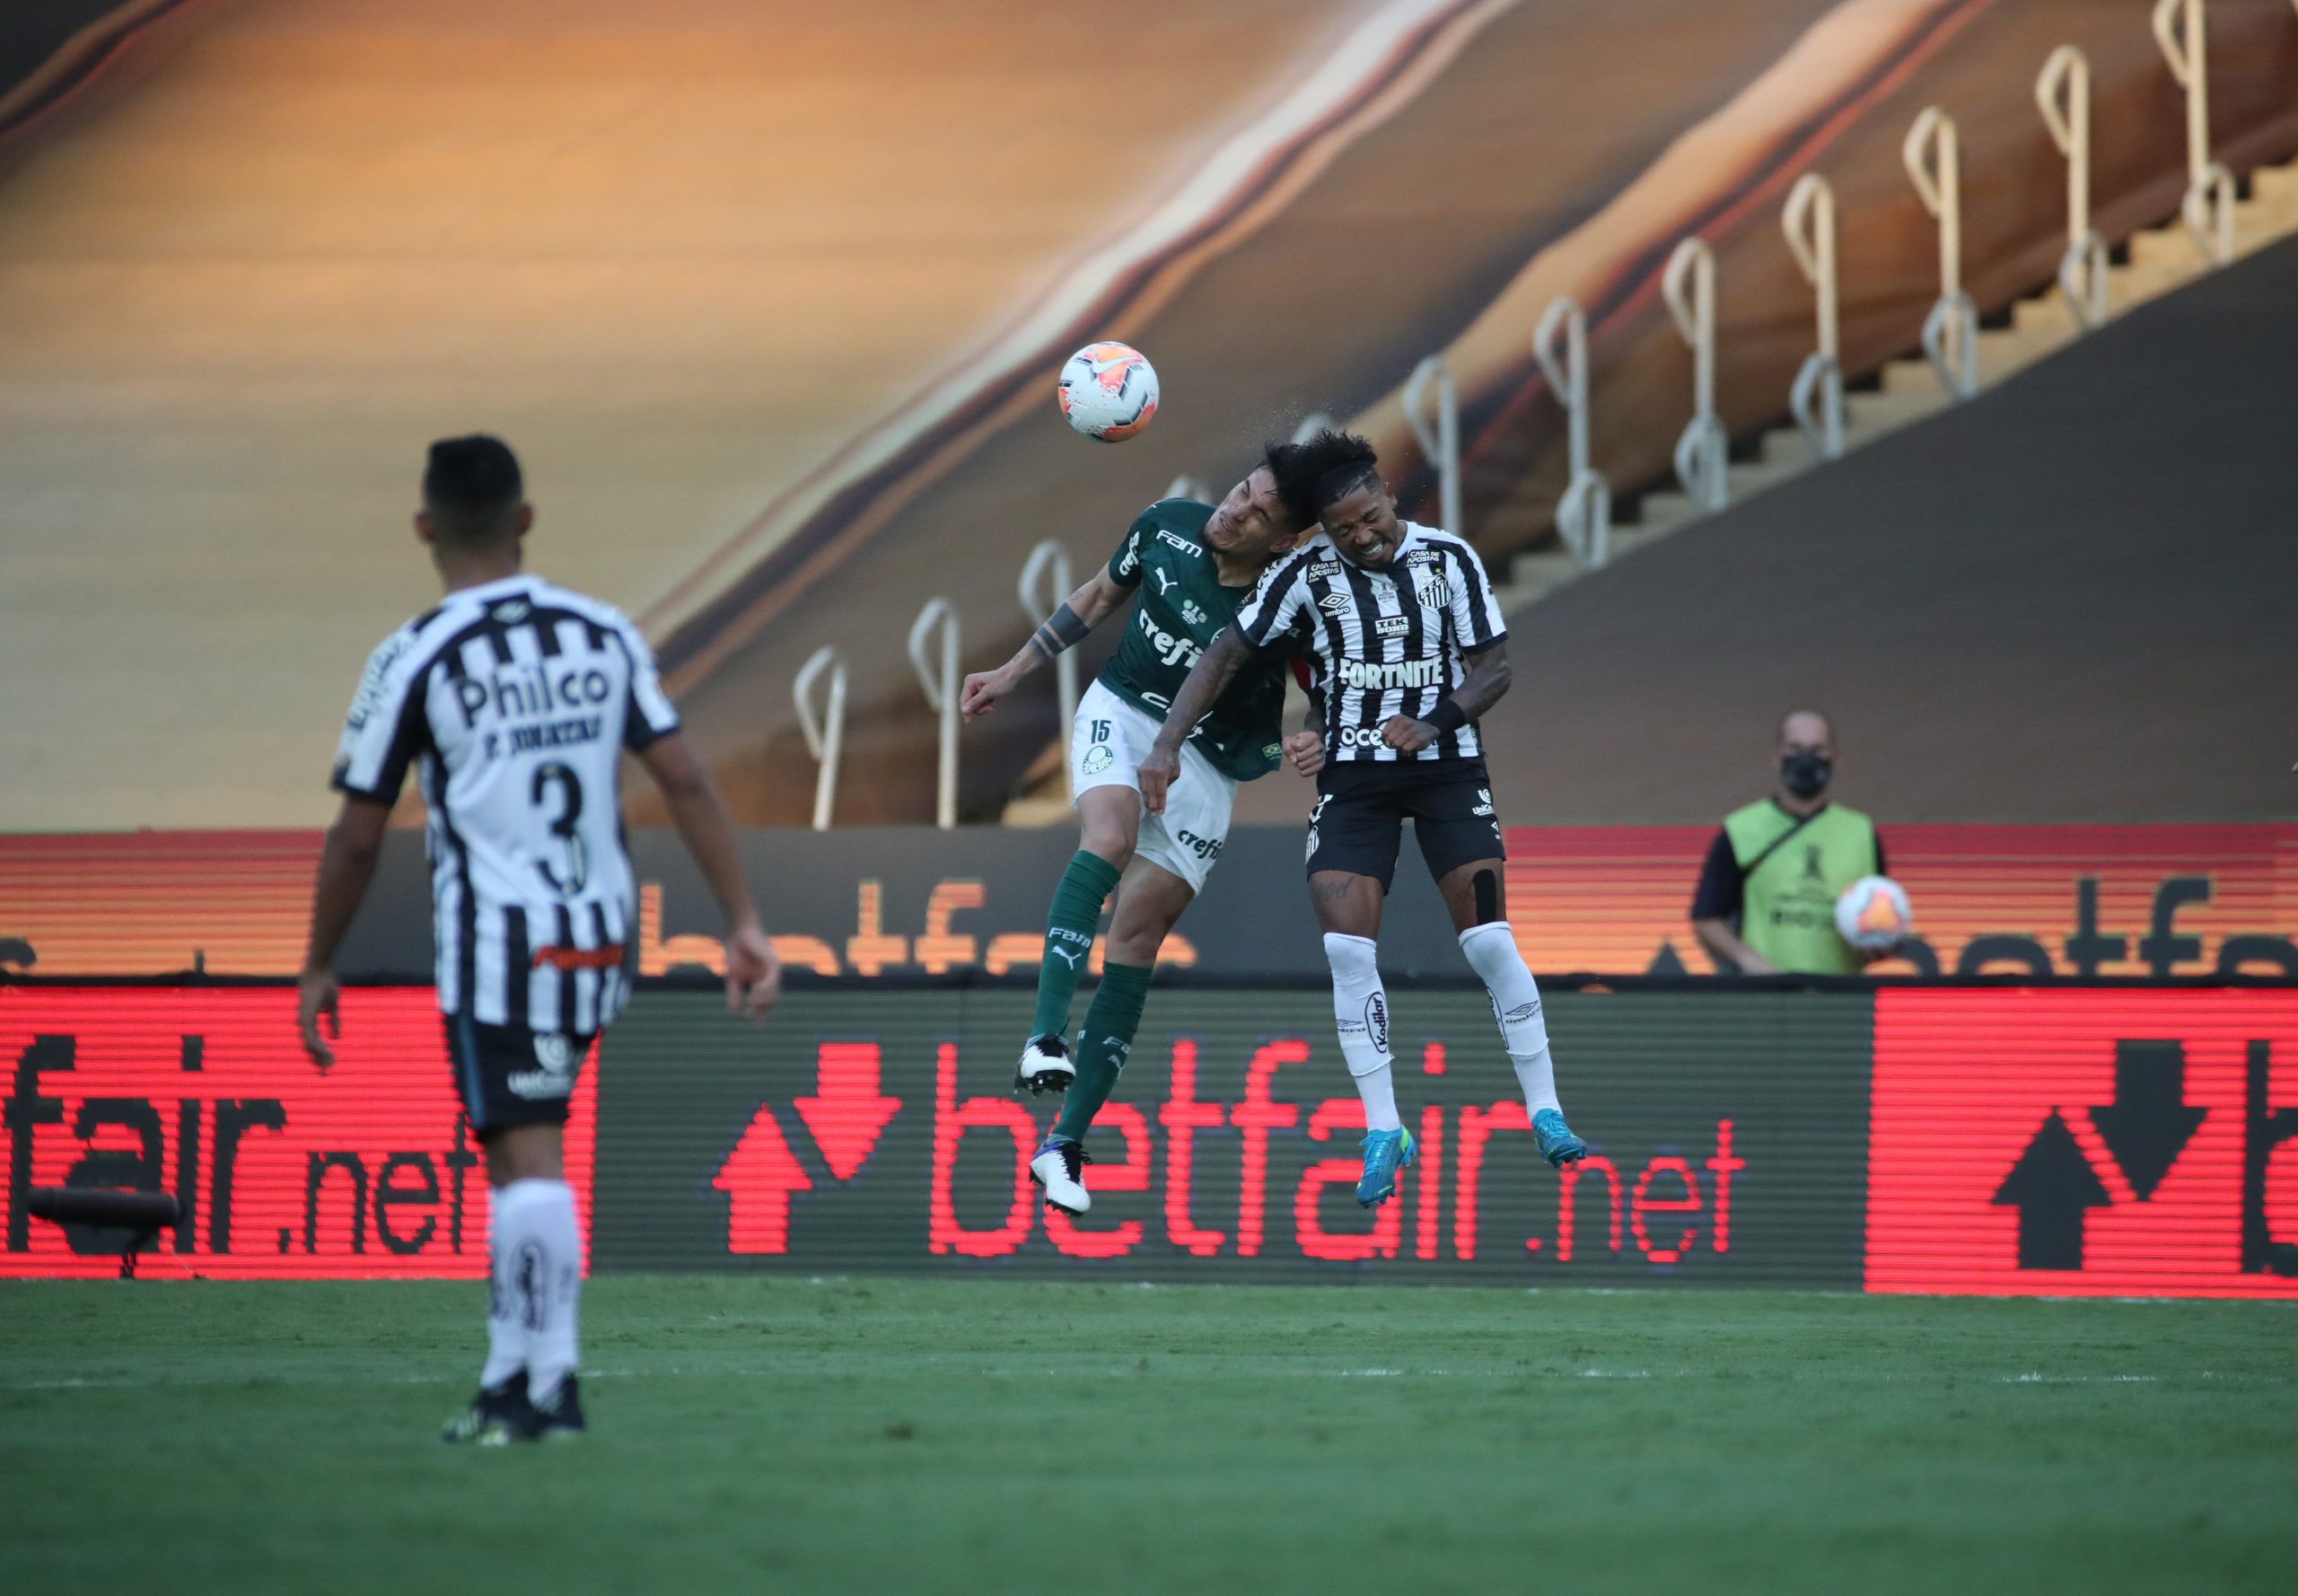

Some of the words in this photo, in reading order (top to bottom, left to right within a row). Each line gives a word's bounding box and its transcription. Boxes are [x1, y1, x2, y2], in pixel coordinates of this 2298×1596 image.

[1309, 567, 1339, 579] APOSTAS
[1311, 563, 1329, 571] CASA
[1325, 607, 1351, 617] umbro
[1377, 618, 1407, 627] TEK
[1338, 654, 1444, 690] FORTNITE
[1091, 719, 1111, 744] 15
[1341, 722, 1388, 747] oce
[529, 759, 587, 897] 3
[1372, 996, 1387, 1046] Kodilar
[929, 1039, 1745, 1264] betfair.net
